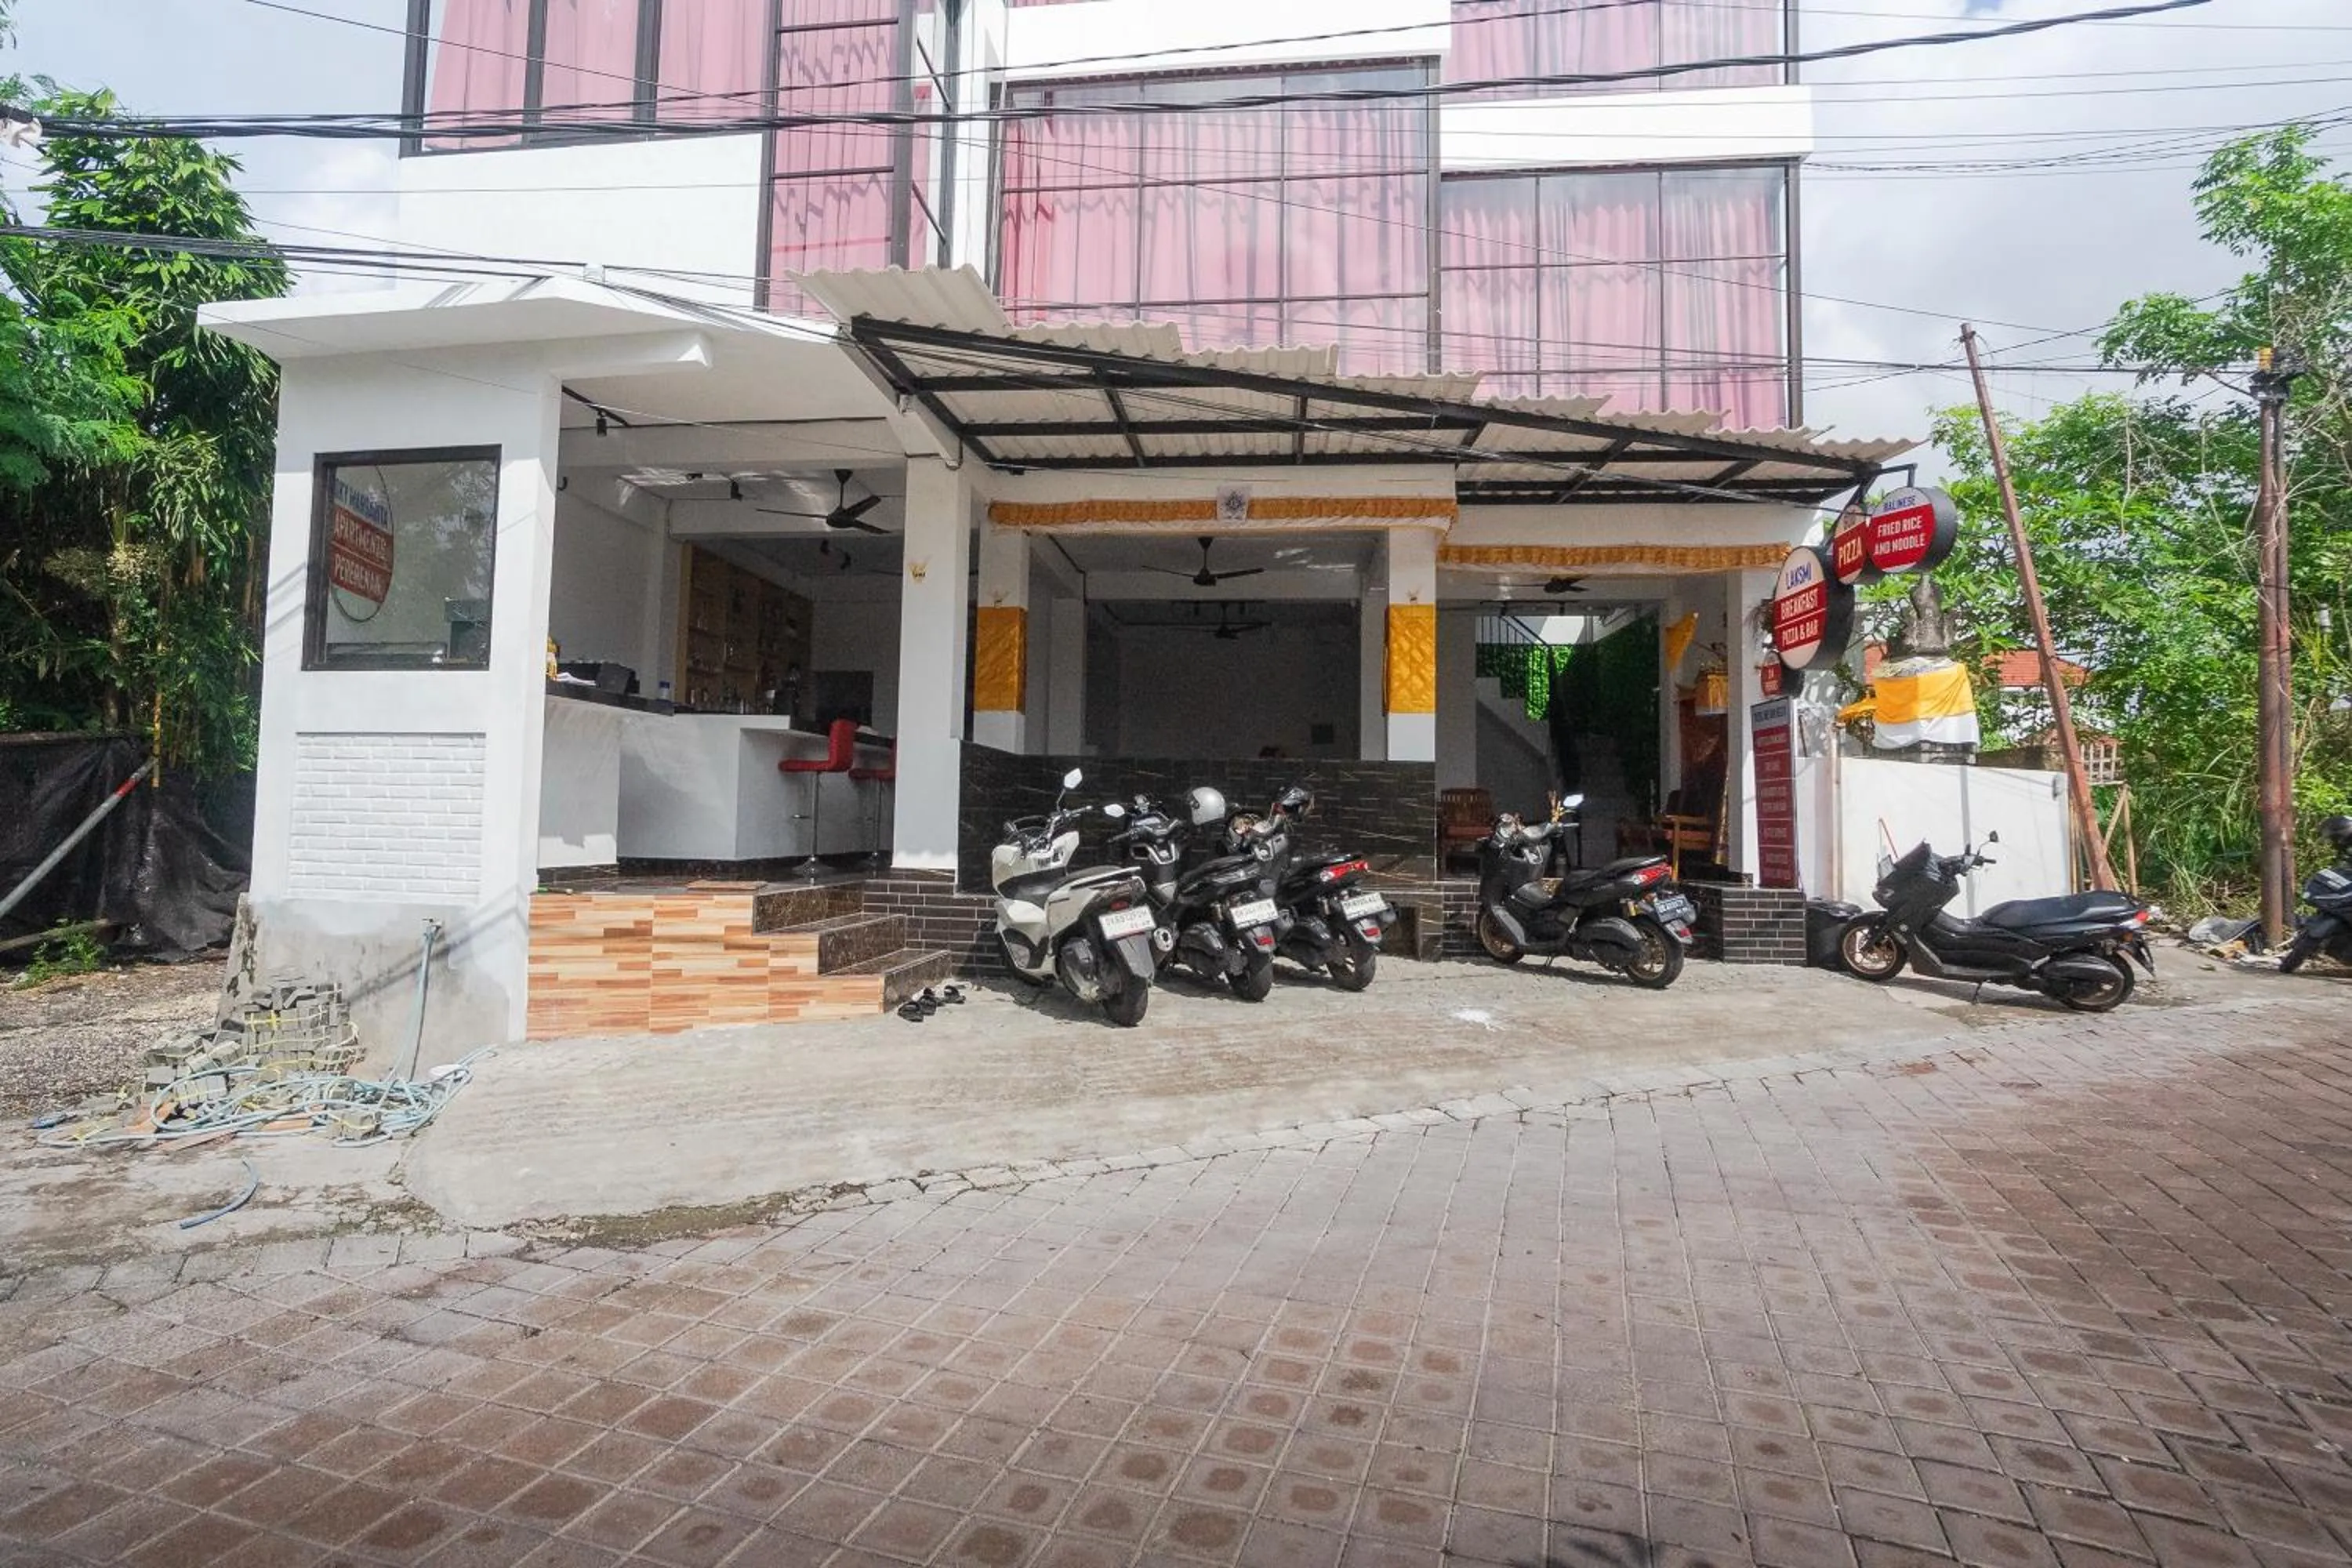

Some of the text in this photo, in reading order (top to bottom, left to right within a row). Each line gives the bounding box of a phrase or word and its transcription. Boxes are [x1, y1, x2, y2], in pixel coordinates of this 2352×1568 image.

[1878, 516, 1922, 537] FRIED RICE
[1838, 537, 1862, 568] PIZZA
[1875, 533, 1925, 555] AND NOODLE
[1785, 563, 1812, 590] LAKSMI
[1780, 588, 1818, 619] BREAKFAST
[1782, 626, 1798, 647] PIZZA
[1806, 619, 1819, 637] BAR
